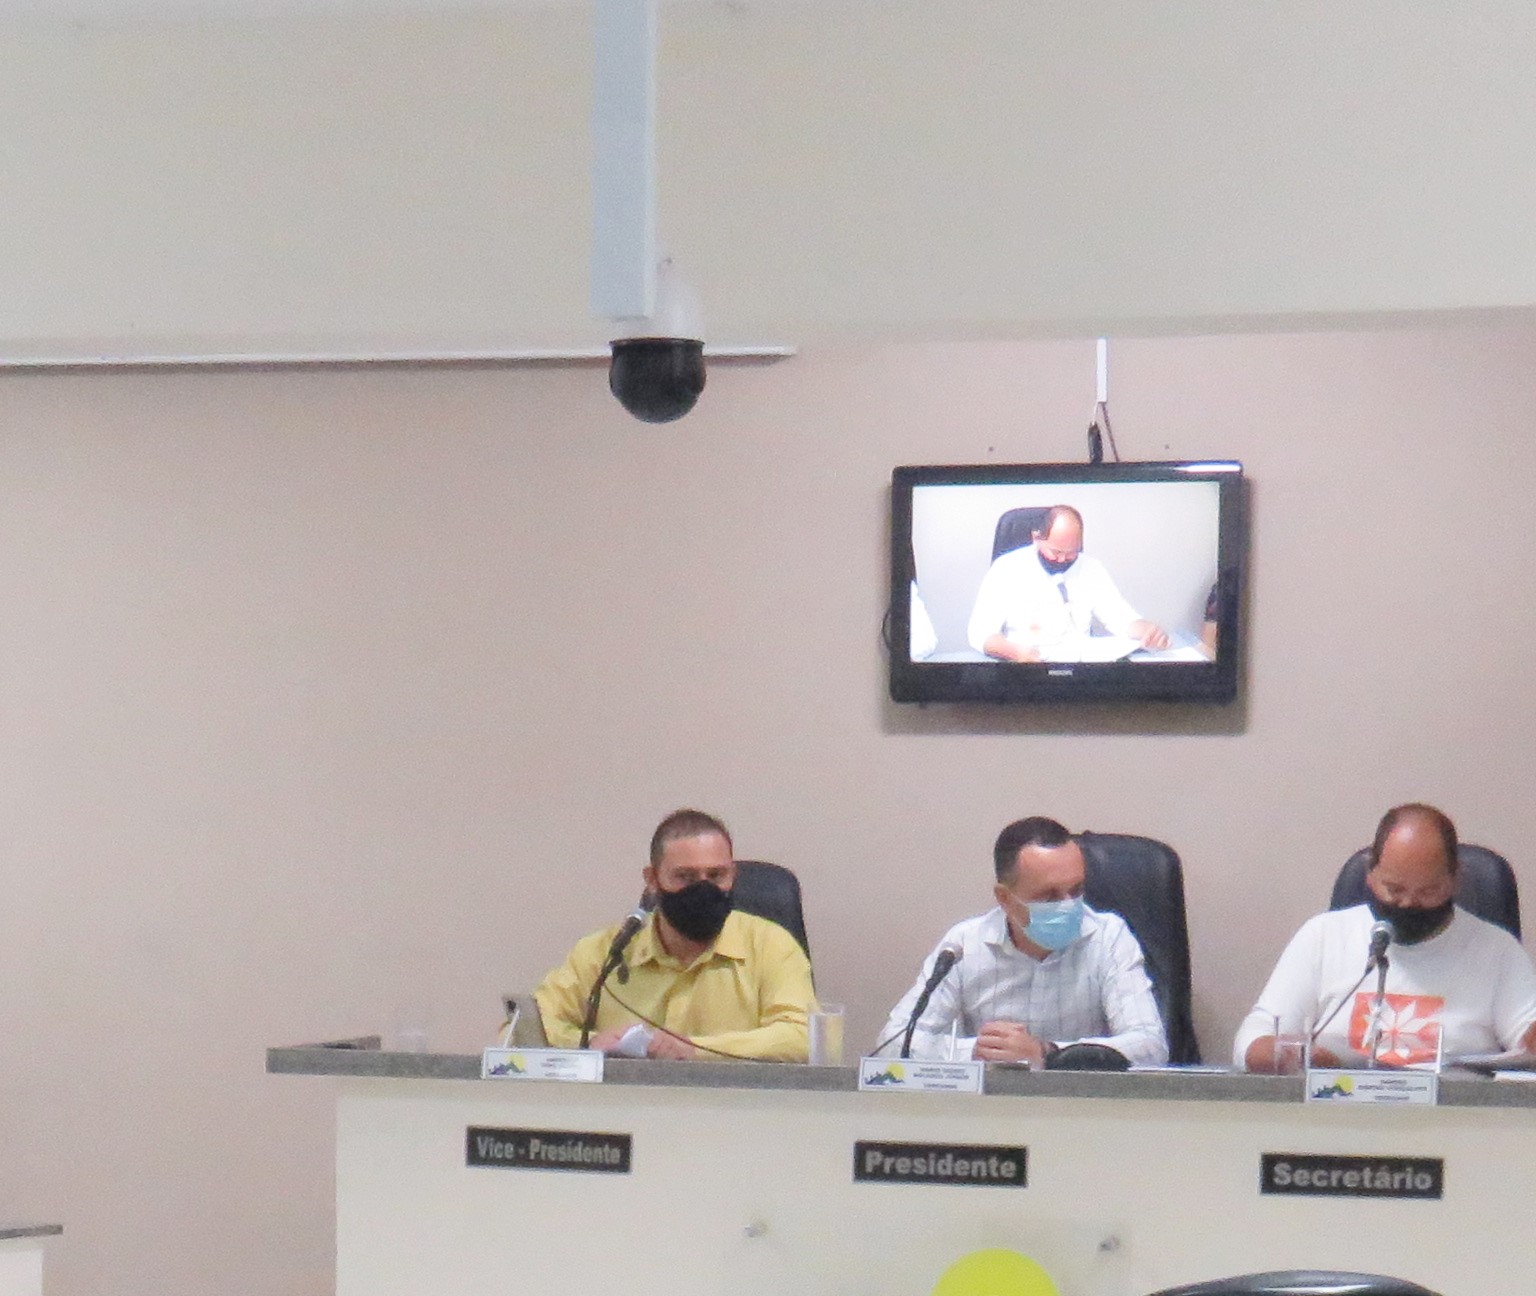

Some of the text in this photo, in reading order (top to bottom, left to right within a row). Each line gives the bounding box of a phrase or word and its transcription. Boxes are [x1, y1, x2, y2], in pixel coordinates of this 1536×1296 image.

[476, 1136, 514, 1159] Vice
[530, 1138, 620, 1164] Presidente
[866, 1151, 1016, 1178] Presidente
[1273, 1162, 1432, 1190] Secretário
